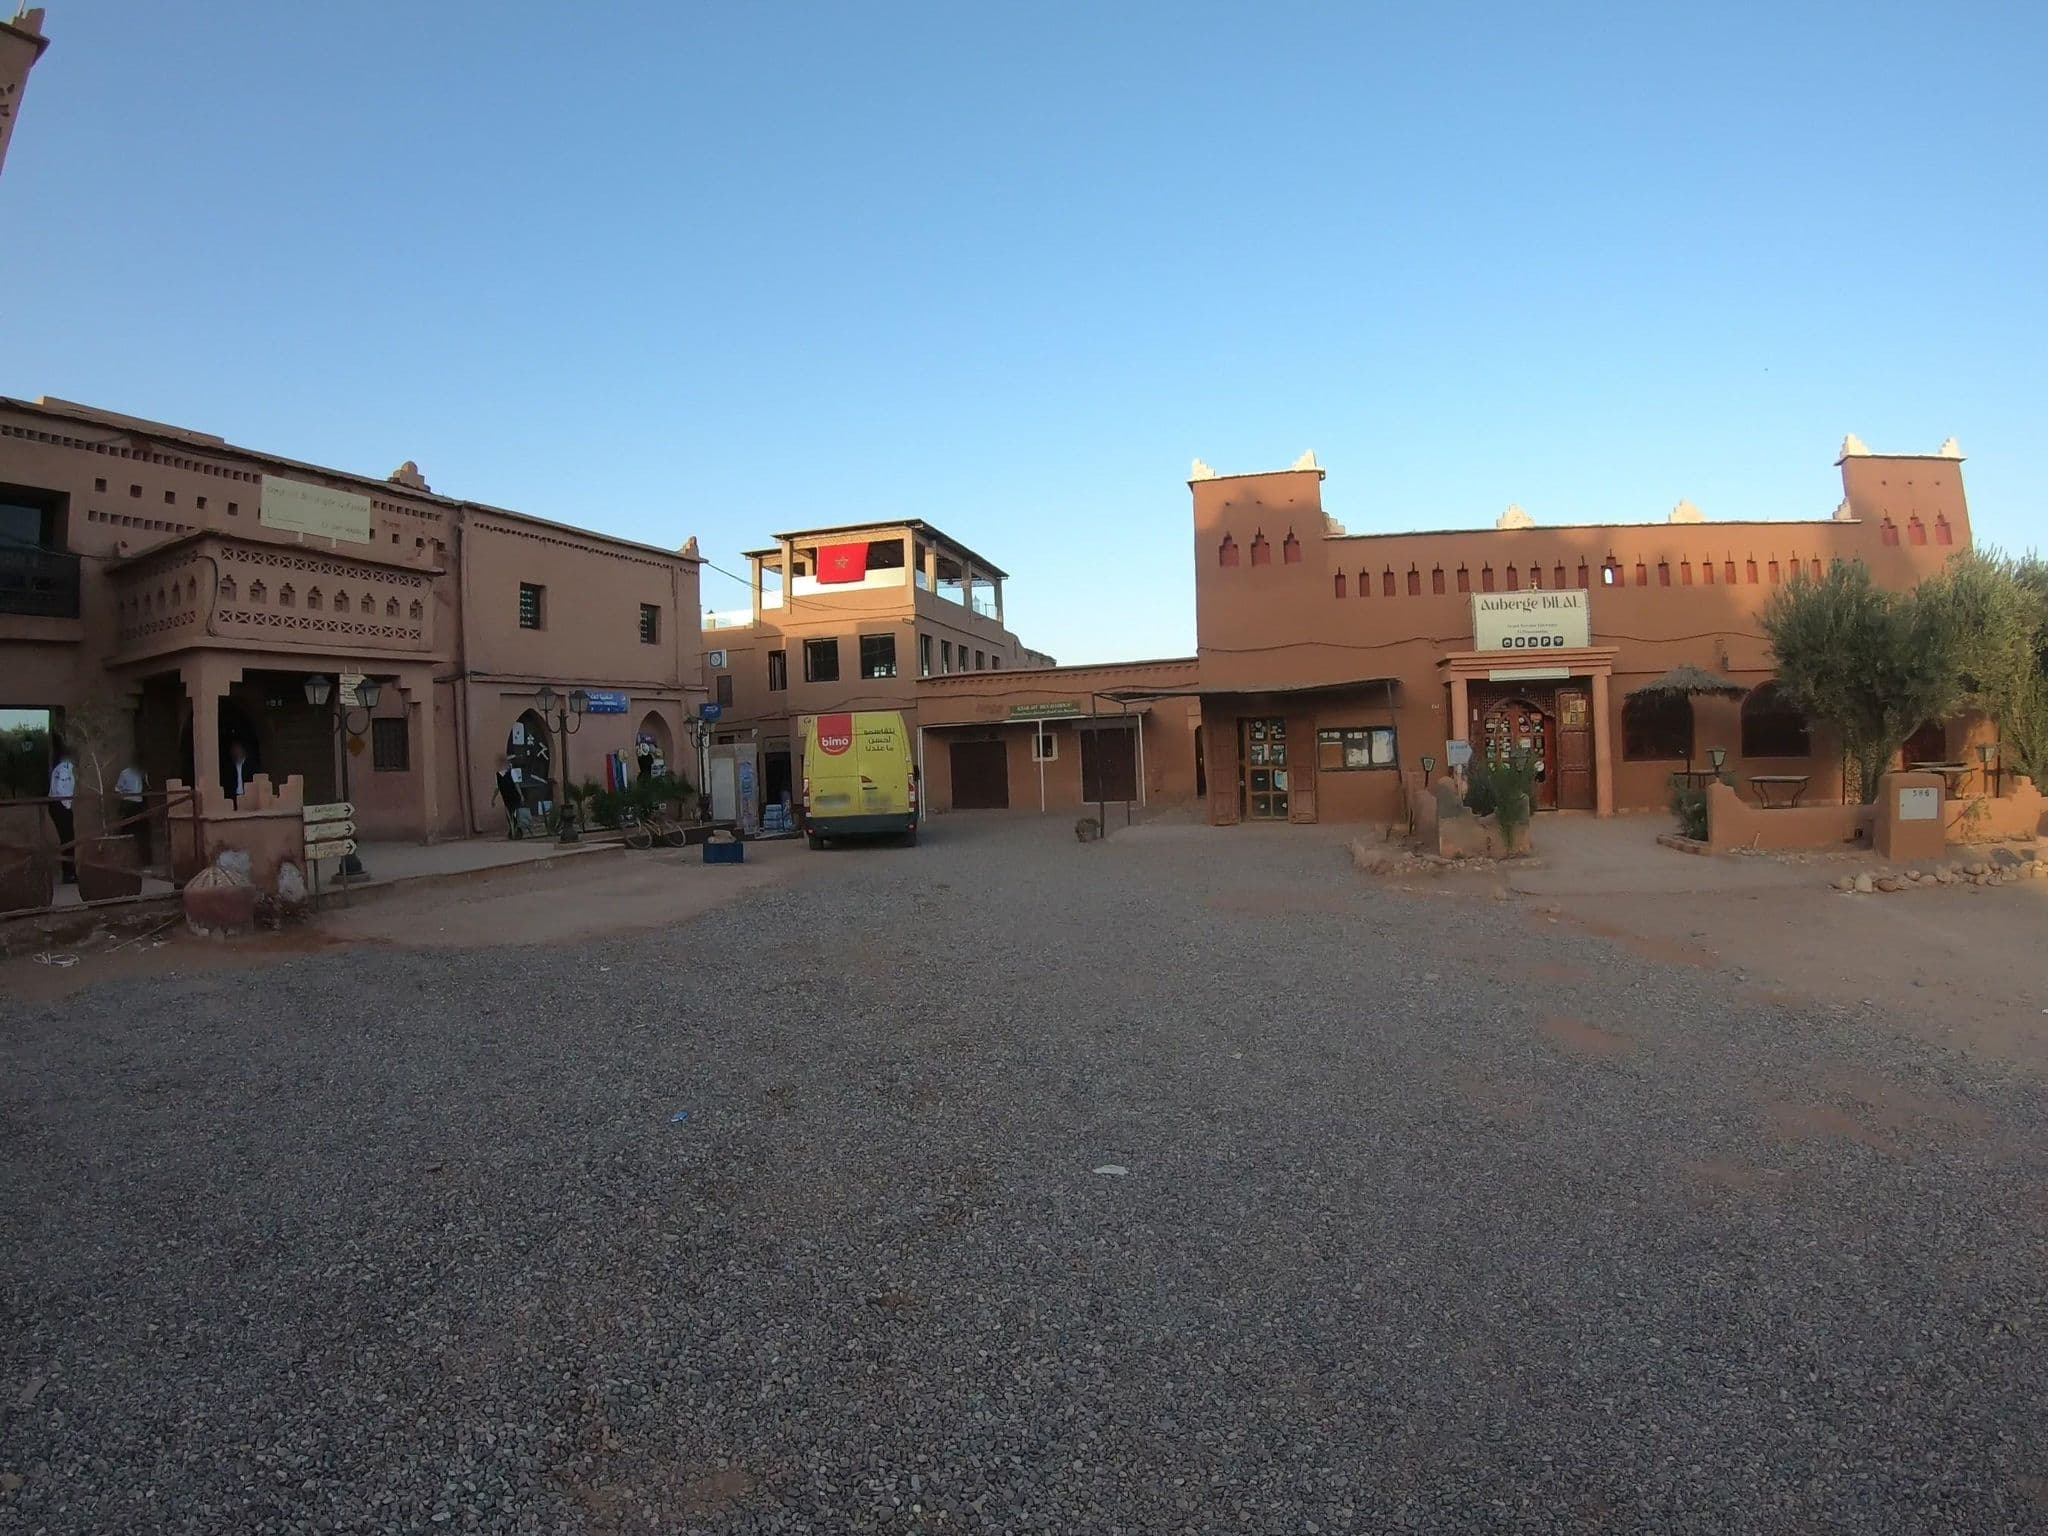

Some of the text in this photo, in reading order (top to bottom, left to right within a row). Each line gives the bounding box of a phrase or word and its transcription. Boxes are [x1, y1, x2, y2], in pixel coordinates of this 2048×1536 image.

[1481, 595, 1581, 613] Auberge BILAL
[821, 737, 849, 747] bimo
